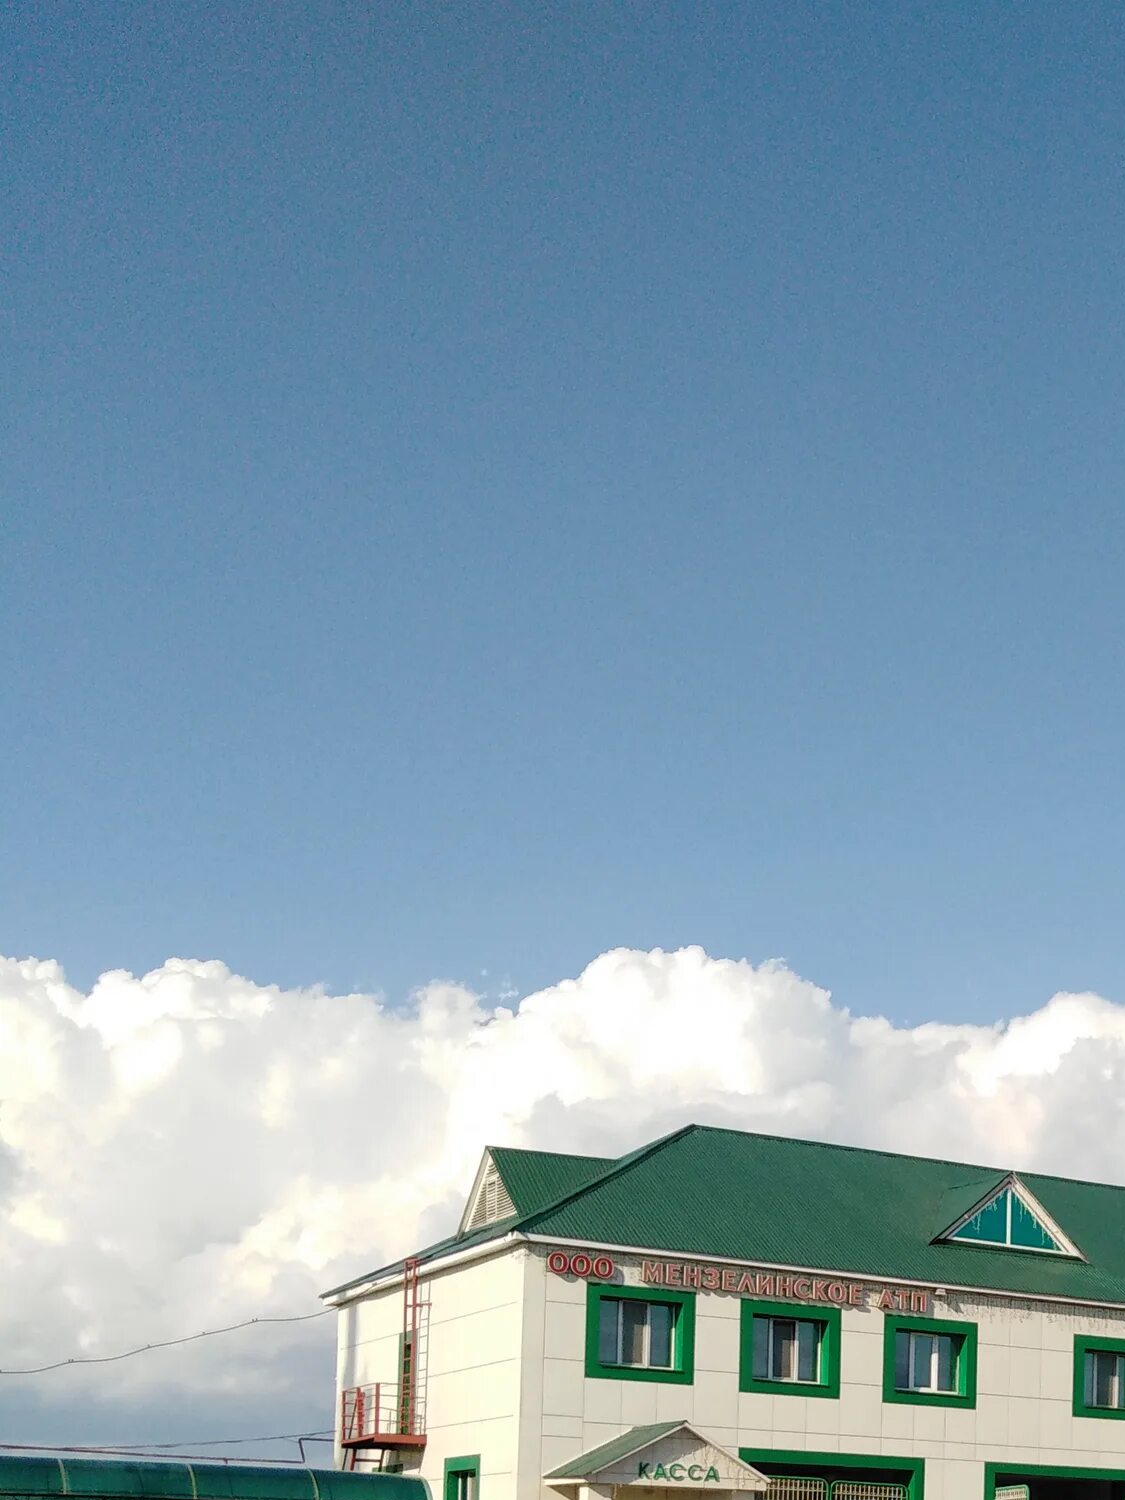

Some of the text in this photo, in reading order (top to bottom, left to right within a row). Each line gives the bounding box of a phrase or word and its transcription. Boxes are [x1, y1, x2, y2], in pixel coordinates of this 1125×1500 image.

[547, 1251, 927, 1313] ООО МЕНЗЕЛИНСКОЕ АТП
[638, 1462, 720, 1482] КАССА
